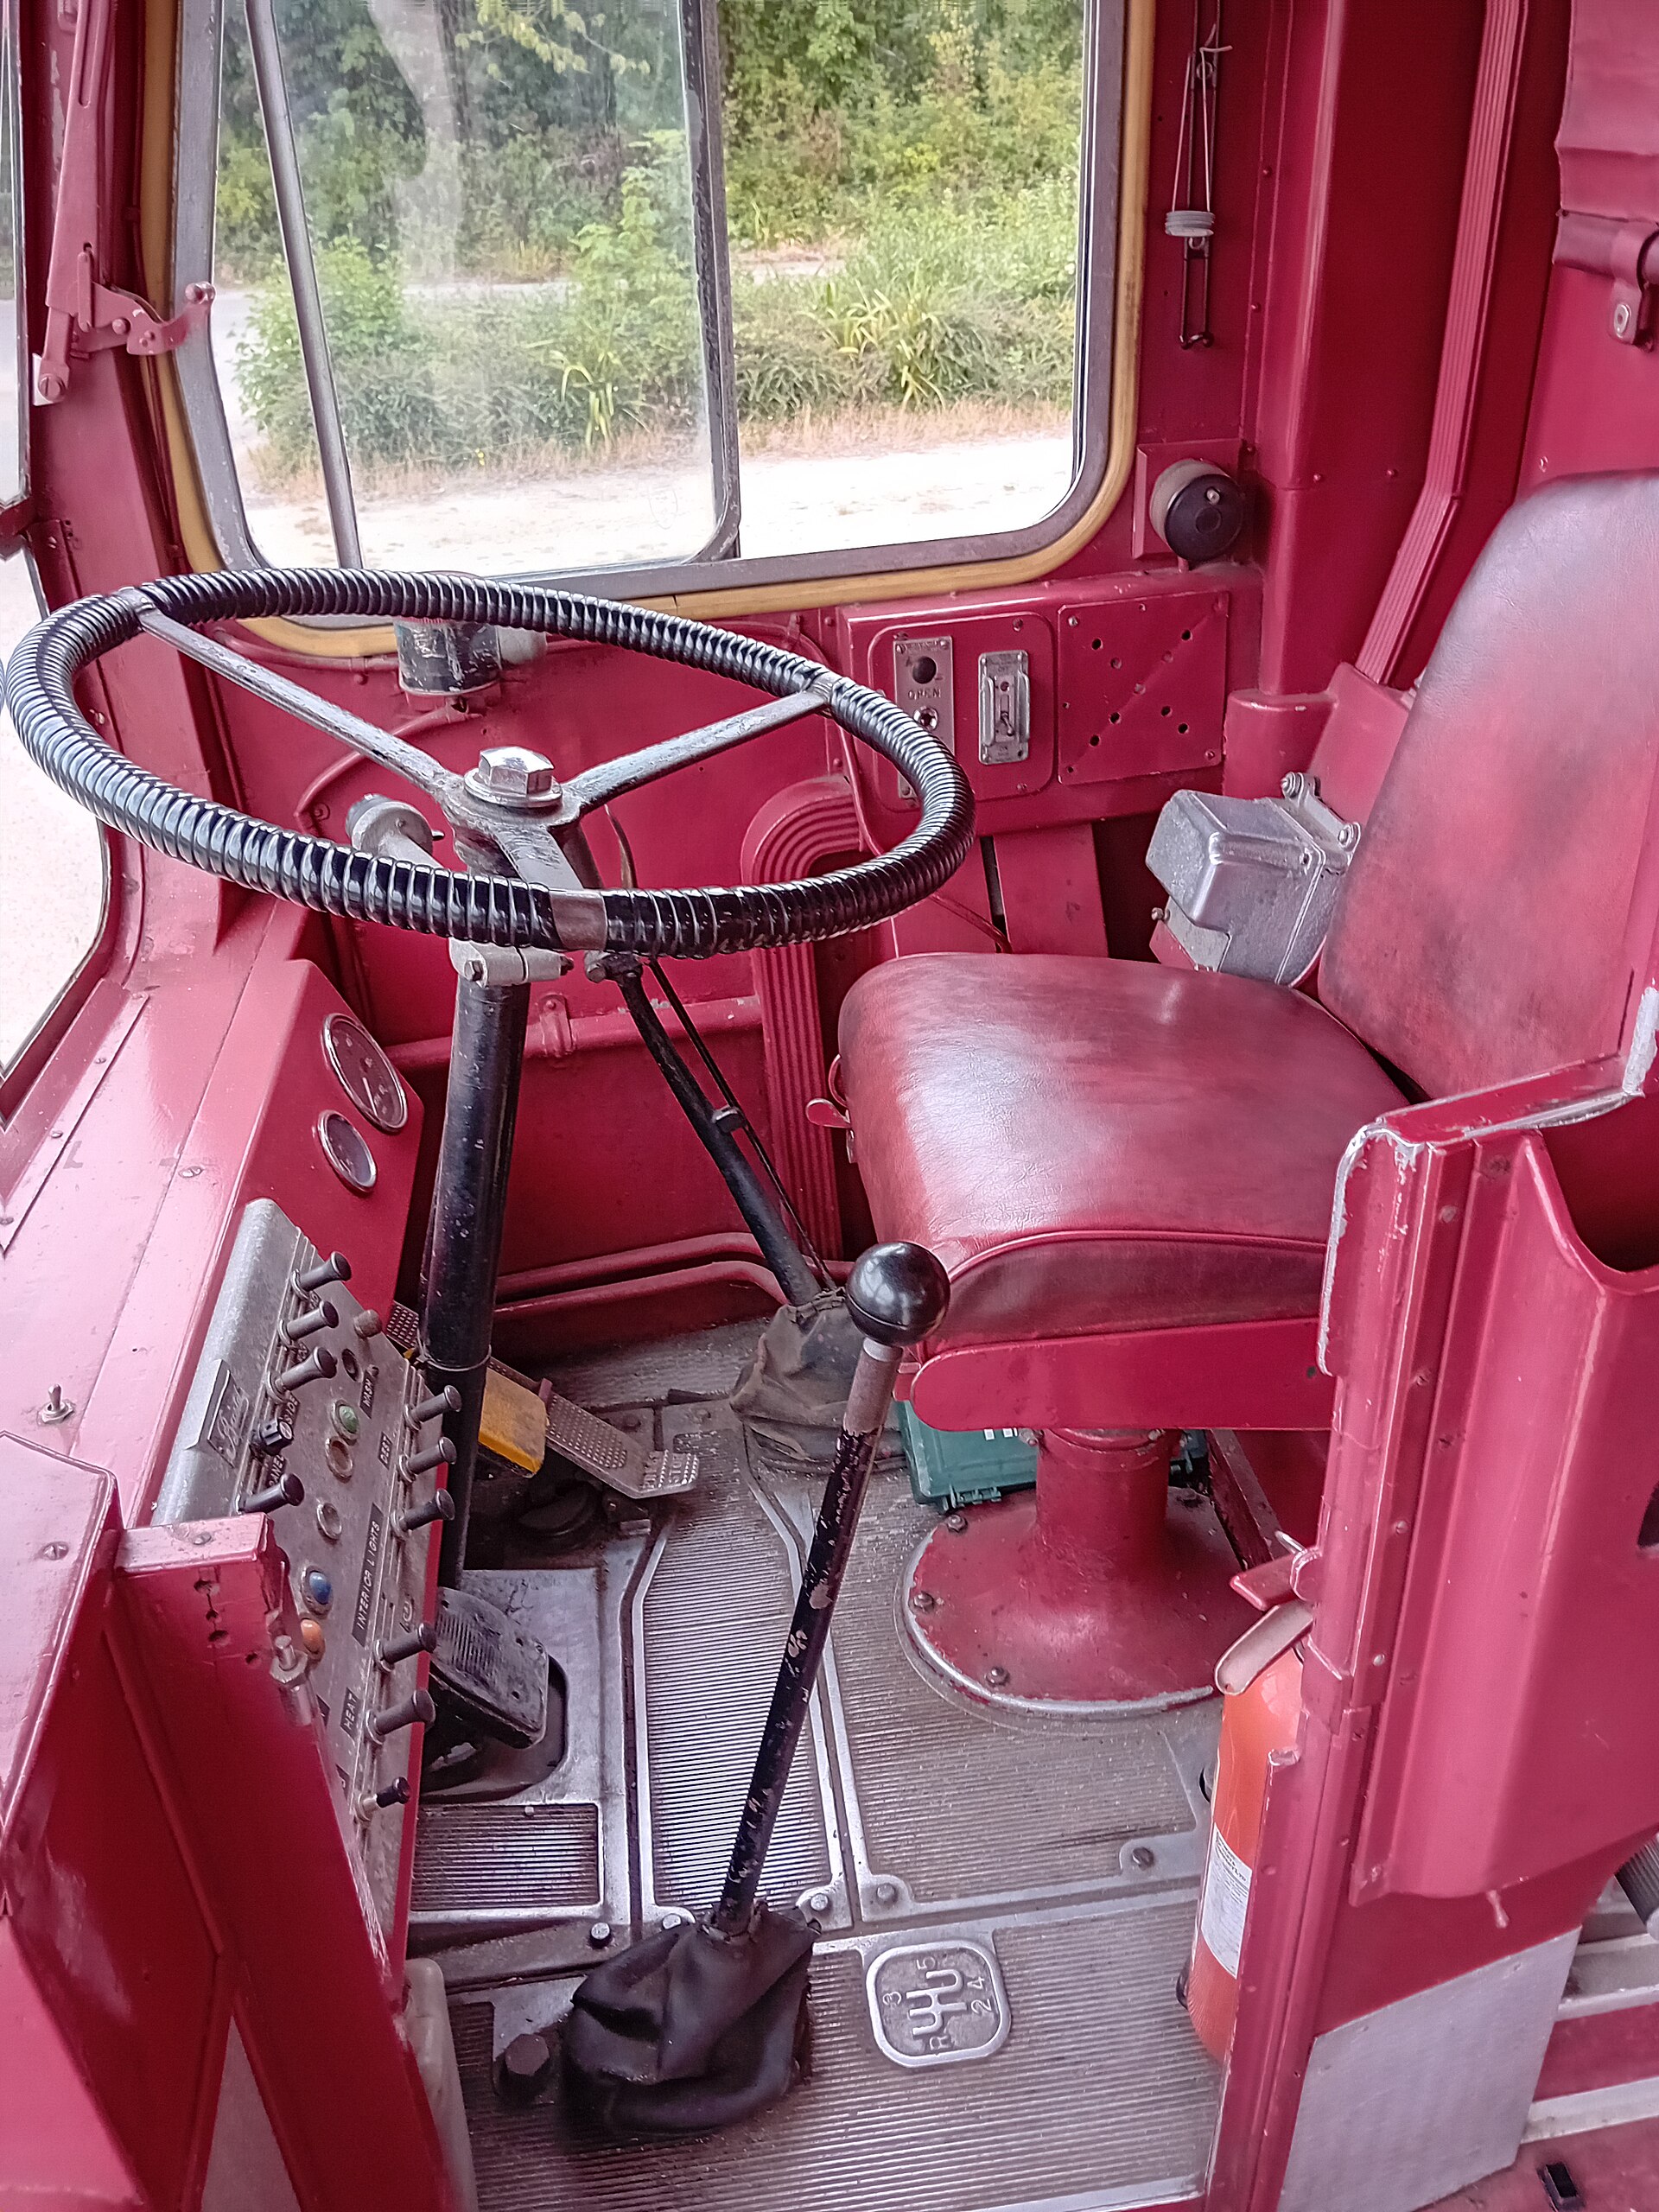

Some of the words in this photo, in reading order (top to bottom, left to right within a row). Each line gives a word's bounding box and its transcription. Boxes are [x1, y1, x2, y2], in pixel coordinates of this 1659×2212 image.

[907, 688, 941, 702] OPEN
[379, 1435, 391, 1465] DEST
[356, 1568, 372, 1630] INTERIOR
[366, 1520, 380, 1567] LIGHTS
[343, 1693, 357, 1730] HEAT
[916, 1956, 936, 1970] 5
[967, 1976, 985, 1989] 4
[882, 1991, 902, 2005] 3
[970, 1998, 992, 2014] 2
[929, 2035, 951, 2050] R
